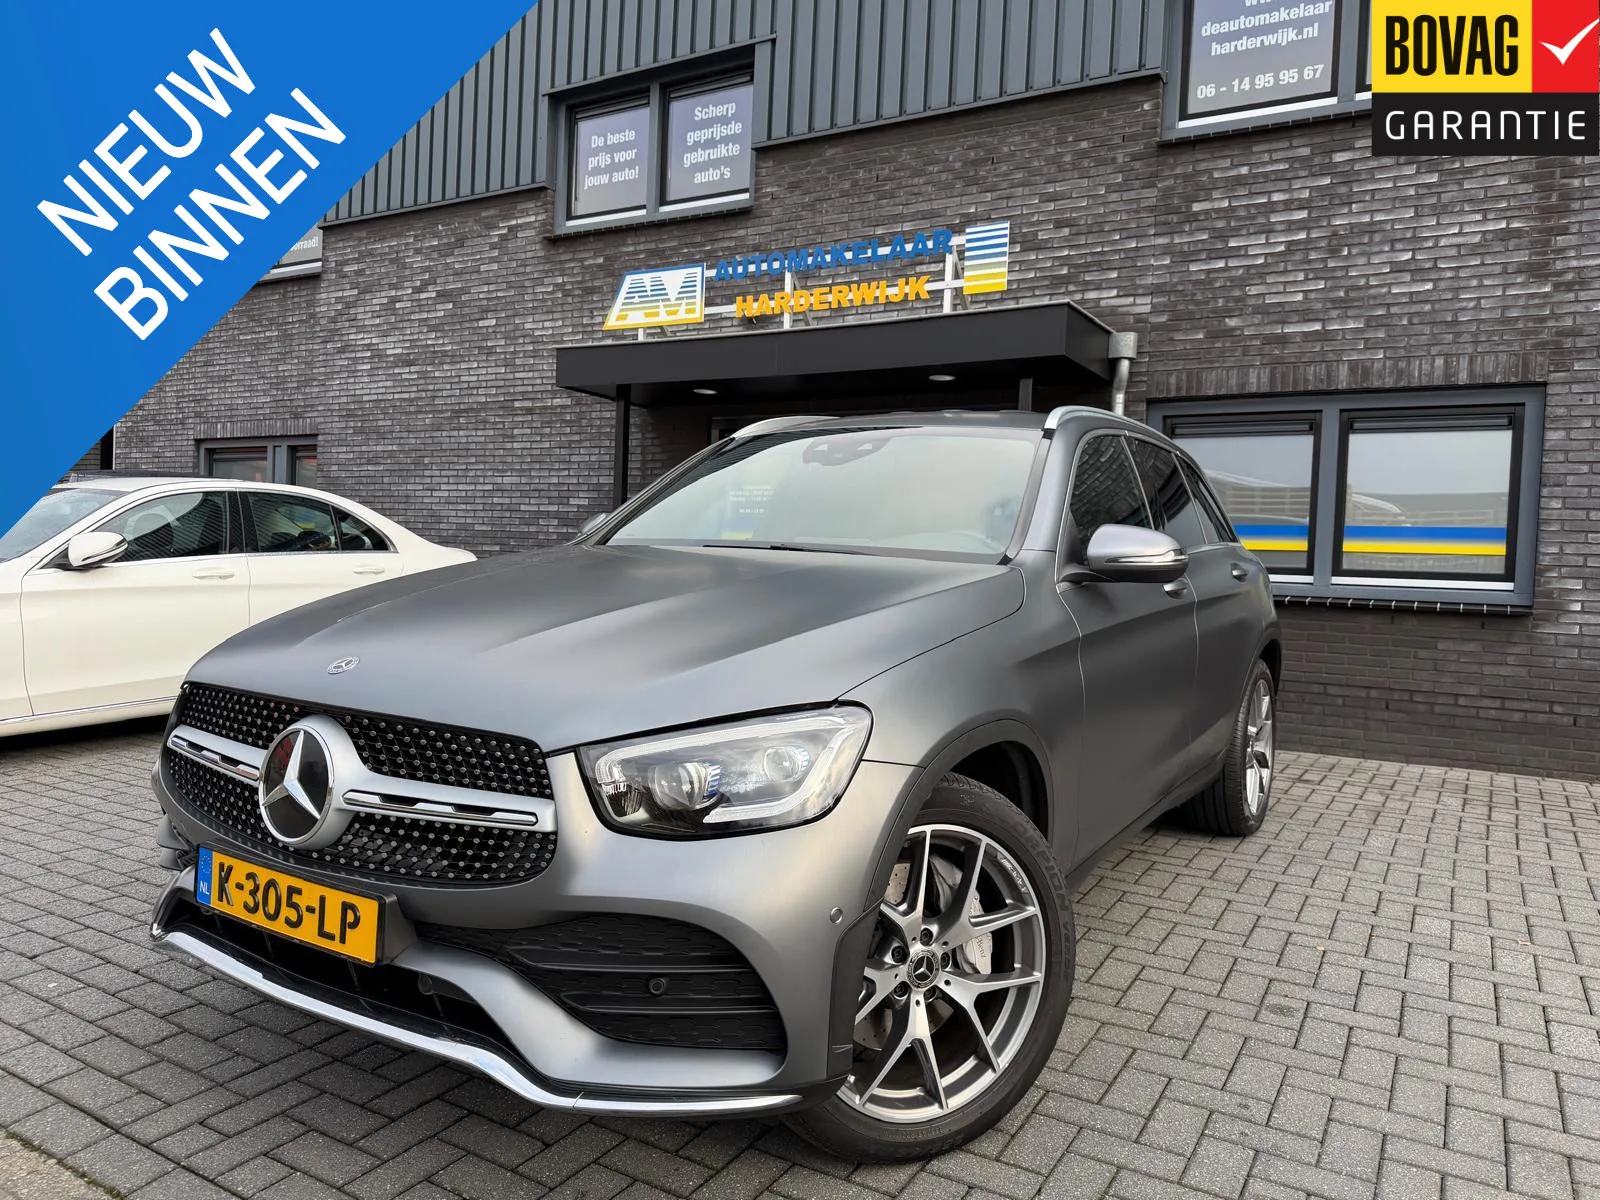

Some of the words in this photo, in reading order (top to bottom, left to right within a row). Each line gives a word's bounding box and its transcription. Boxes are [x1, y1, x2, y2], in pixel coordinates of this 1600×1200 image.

[1201, 1, 1333, 36] deautomakelaar
[1210, 22, 1319, 56] harderwijk.nl
[1197, 84, 1216, 99] 06
[1232, 77, 1250, 93] 14
[1254, 72, 1274, 89] 95
[1279, 68, 1299, 84] 95
[1303, 64, 1324, 80] 67
[694, 102, 736, 121] Scherp
[591, 134, 604, 148] De
[606, 128, 636, 145] beste
[686, 121, 743, 146] geprijsde
[588, 152, 612, 170] prijs
[613, 147, 637, 163] voor
[683, 142, 741, 167] gebruikte
[583, 172, 609, 190] jouw
[612, 166, 639, 182] auto!
[693, 166, 731, 184] auto's
[712, 228, 953, 282] AUTOMAKELAAR
[735, 275, 932, 319] HARDERWIJK
[199, 880, 210, 895] NL
[217, 861, 361, 945] K-305-LP
